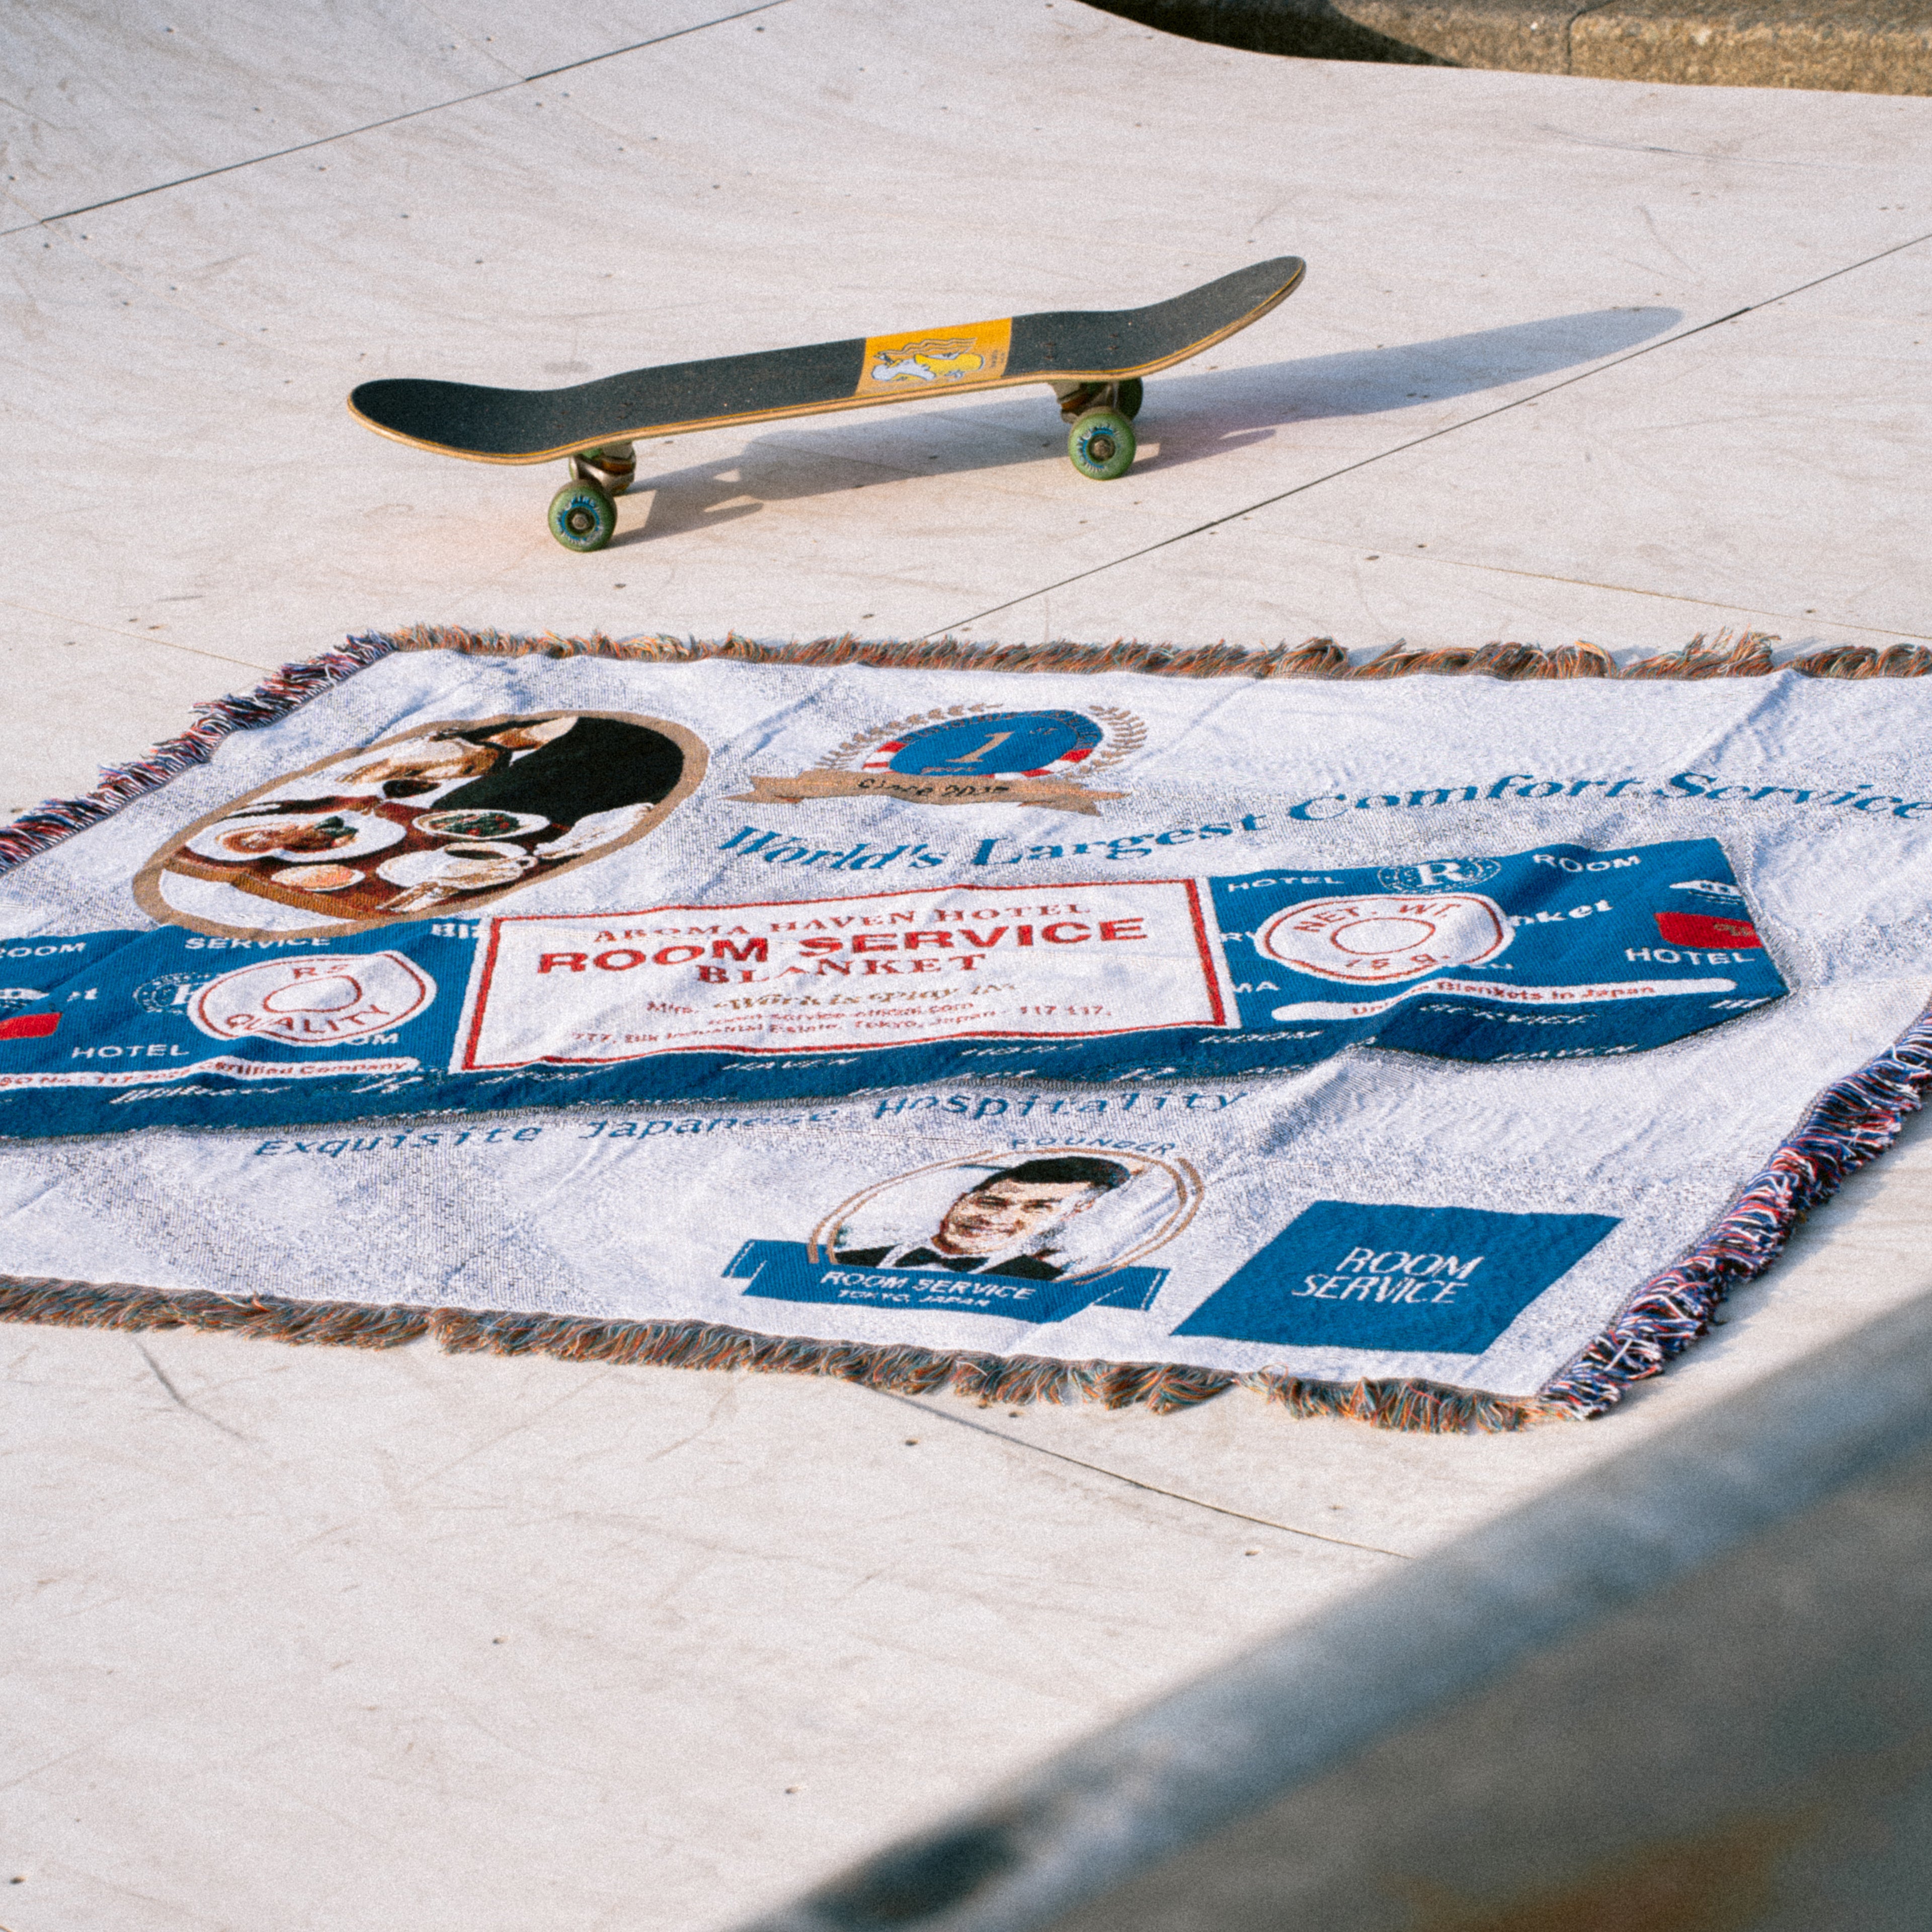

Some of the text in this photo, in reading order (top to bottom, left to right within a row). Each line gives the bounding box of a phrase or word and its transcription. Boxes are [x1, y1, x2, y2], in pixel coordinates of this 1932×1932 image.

[718, 772, 1932, 870] World's Largest Comfort Service
[1533, 854, 1642, 872] ROOM
[1228, 876, 1345, 893] HOTEL
[594, 904, 1091, 942] AROMA HAVEN HOTEL
[185, 937, 331, 949] SERVICE
[537, 917, 1148, 974] ROOM SERVICE
[1626, 947, 1755, 965] HOTEL
[696, 953, 987, 984] BLANKET
[226, 1004, 390, 1033] QUALITY
[71, 1044, 190, 1058] HOTEL
[253, 1124, 543, 1158] Exquisite
[874, 1091, 1248, 1120] Hospitality
[1336, 1246, 1485, 1280] ROOM
[820, 1270, 1036, 1300] ROOM SERVICE
[1291, 1273, 1469, 1304] SERVICE
[919, 1295, 991, 1307] JAPAN
